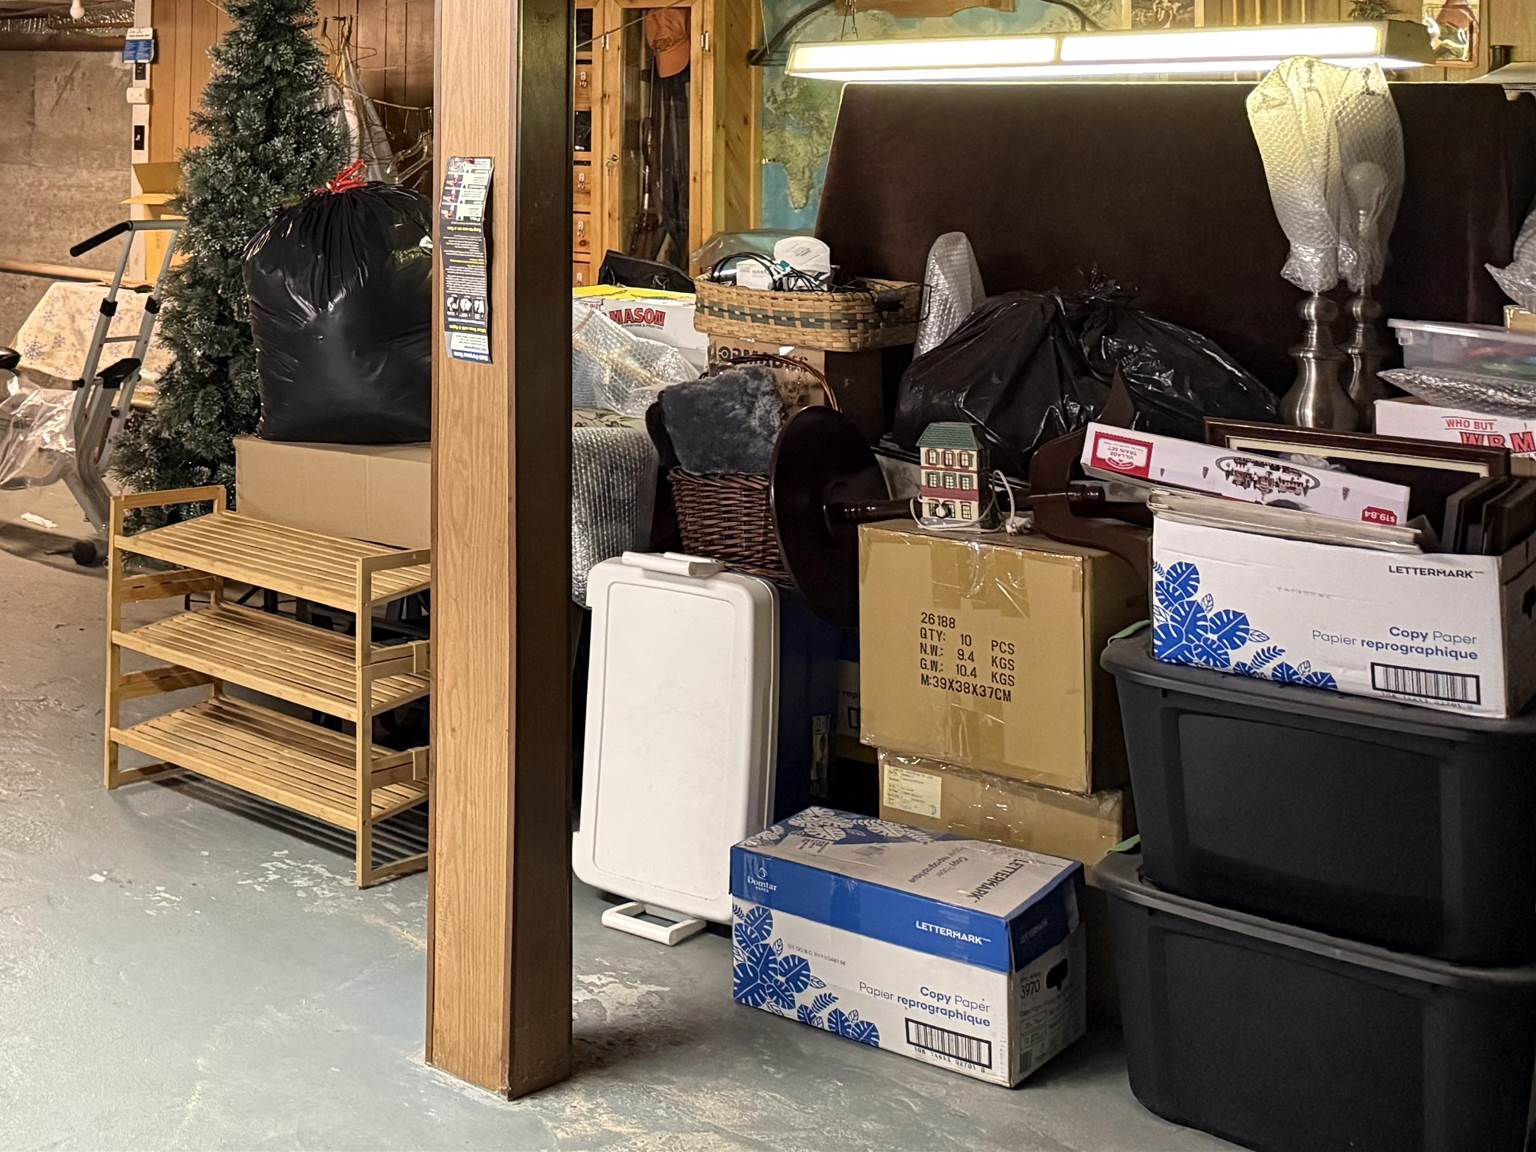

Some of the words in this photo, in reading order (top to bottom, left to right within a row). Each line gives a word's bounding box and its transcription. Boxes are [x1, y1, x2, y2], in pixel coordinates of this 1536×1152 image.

[609, 308, 666, 327] MASON
[1445, 419, 1471, 428] WHO
[1473, 421, 1495, 430] BUT
[1388, 564, 1474, 579] LETTERMARK
[920, 611, 956, 629] 26188
[920, 627, 946, 642] QTY:
[960, 633, 972, 647] 10
[991, 639, 1015, 655] PCS
[1312, 629, 1357, 646] Papier
[1361, 638, 1478, 660] reprographique
[1389, 626, 1428, 642] Copy
[1433, 630, 1477, 645] Paper
[957, 648, 975, 663] 9.4
[991, 655, 1015, 671] KGS
[920, 673, 1012, 702] M:39X38X37CM
[955, 664, 977, 679] 10.4
[991, 671, 1015, 687] KGS
[968, 858, 1029, 902] LETTERMARK
[915, 920, 984, 945] LETTERMARK
[859, 981, 895, 1000] Papier
[897, 995, 991, 1027] reprographique
[920, 986, 952, 1004] Copy
[954, 995, 991, 1013] Paper
